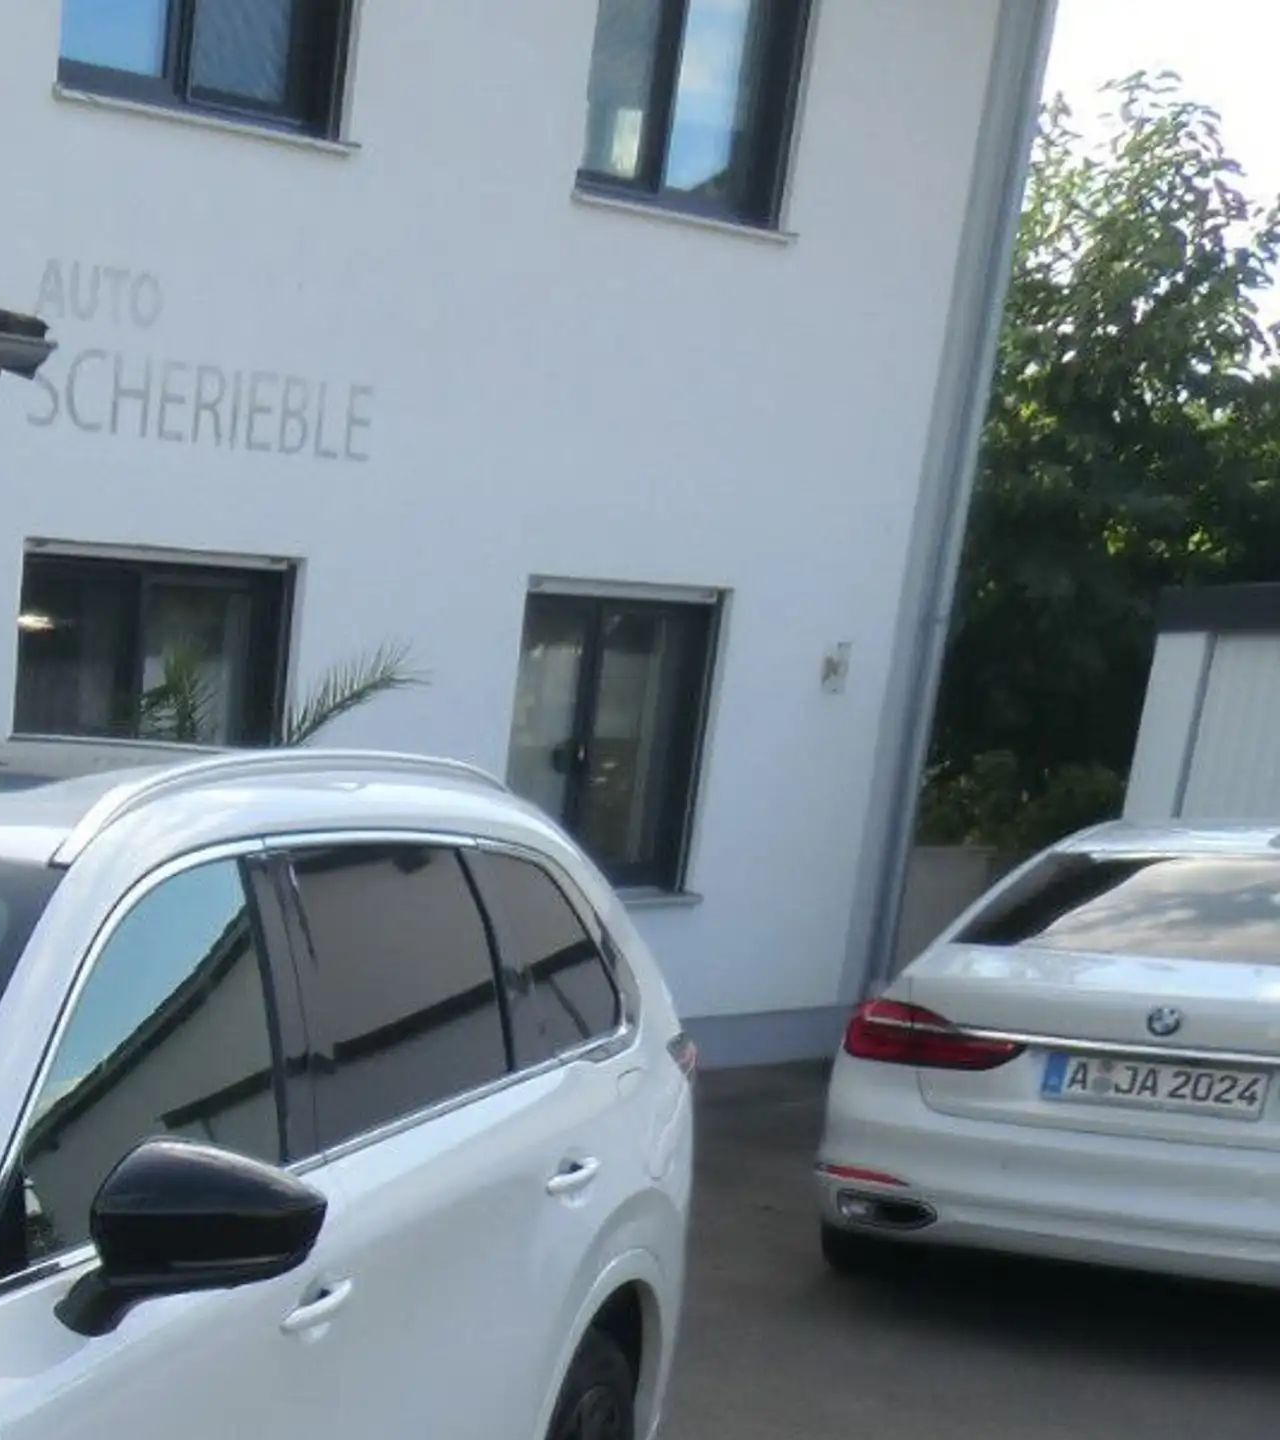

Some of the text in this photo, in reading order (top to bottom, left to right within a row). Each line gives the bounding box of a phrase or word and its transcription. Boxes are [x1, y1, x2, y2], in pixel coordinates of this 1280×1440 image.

[36, 258, 165, 328] AUTO
[27, 347, 375, 462] SCHERIEBLE
[1066, 1062, 1261, 1107] A JA 2024
